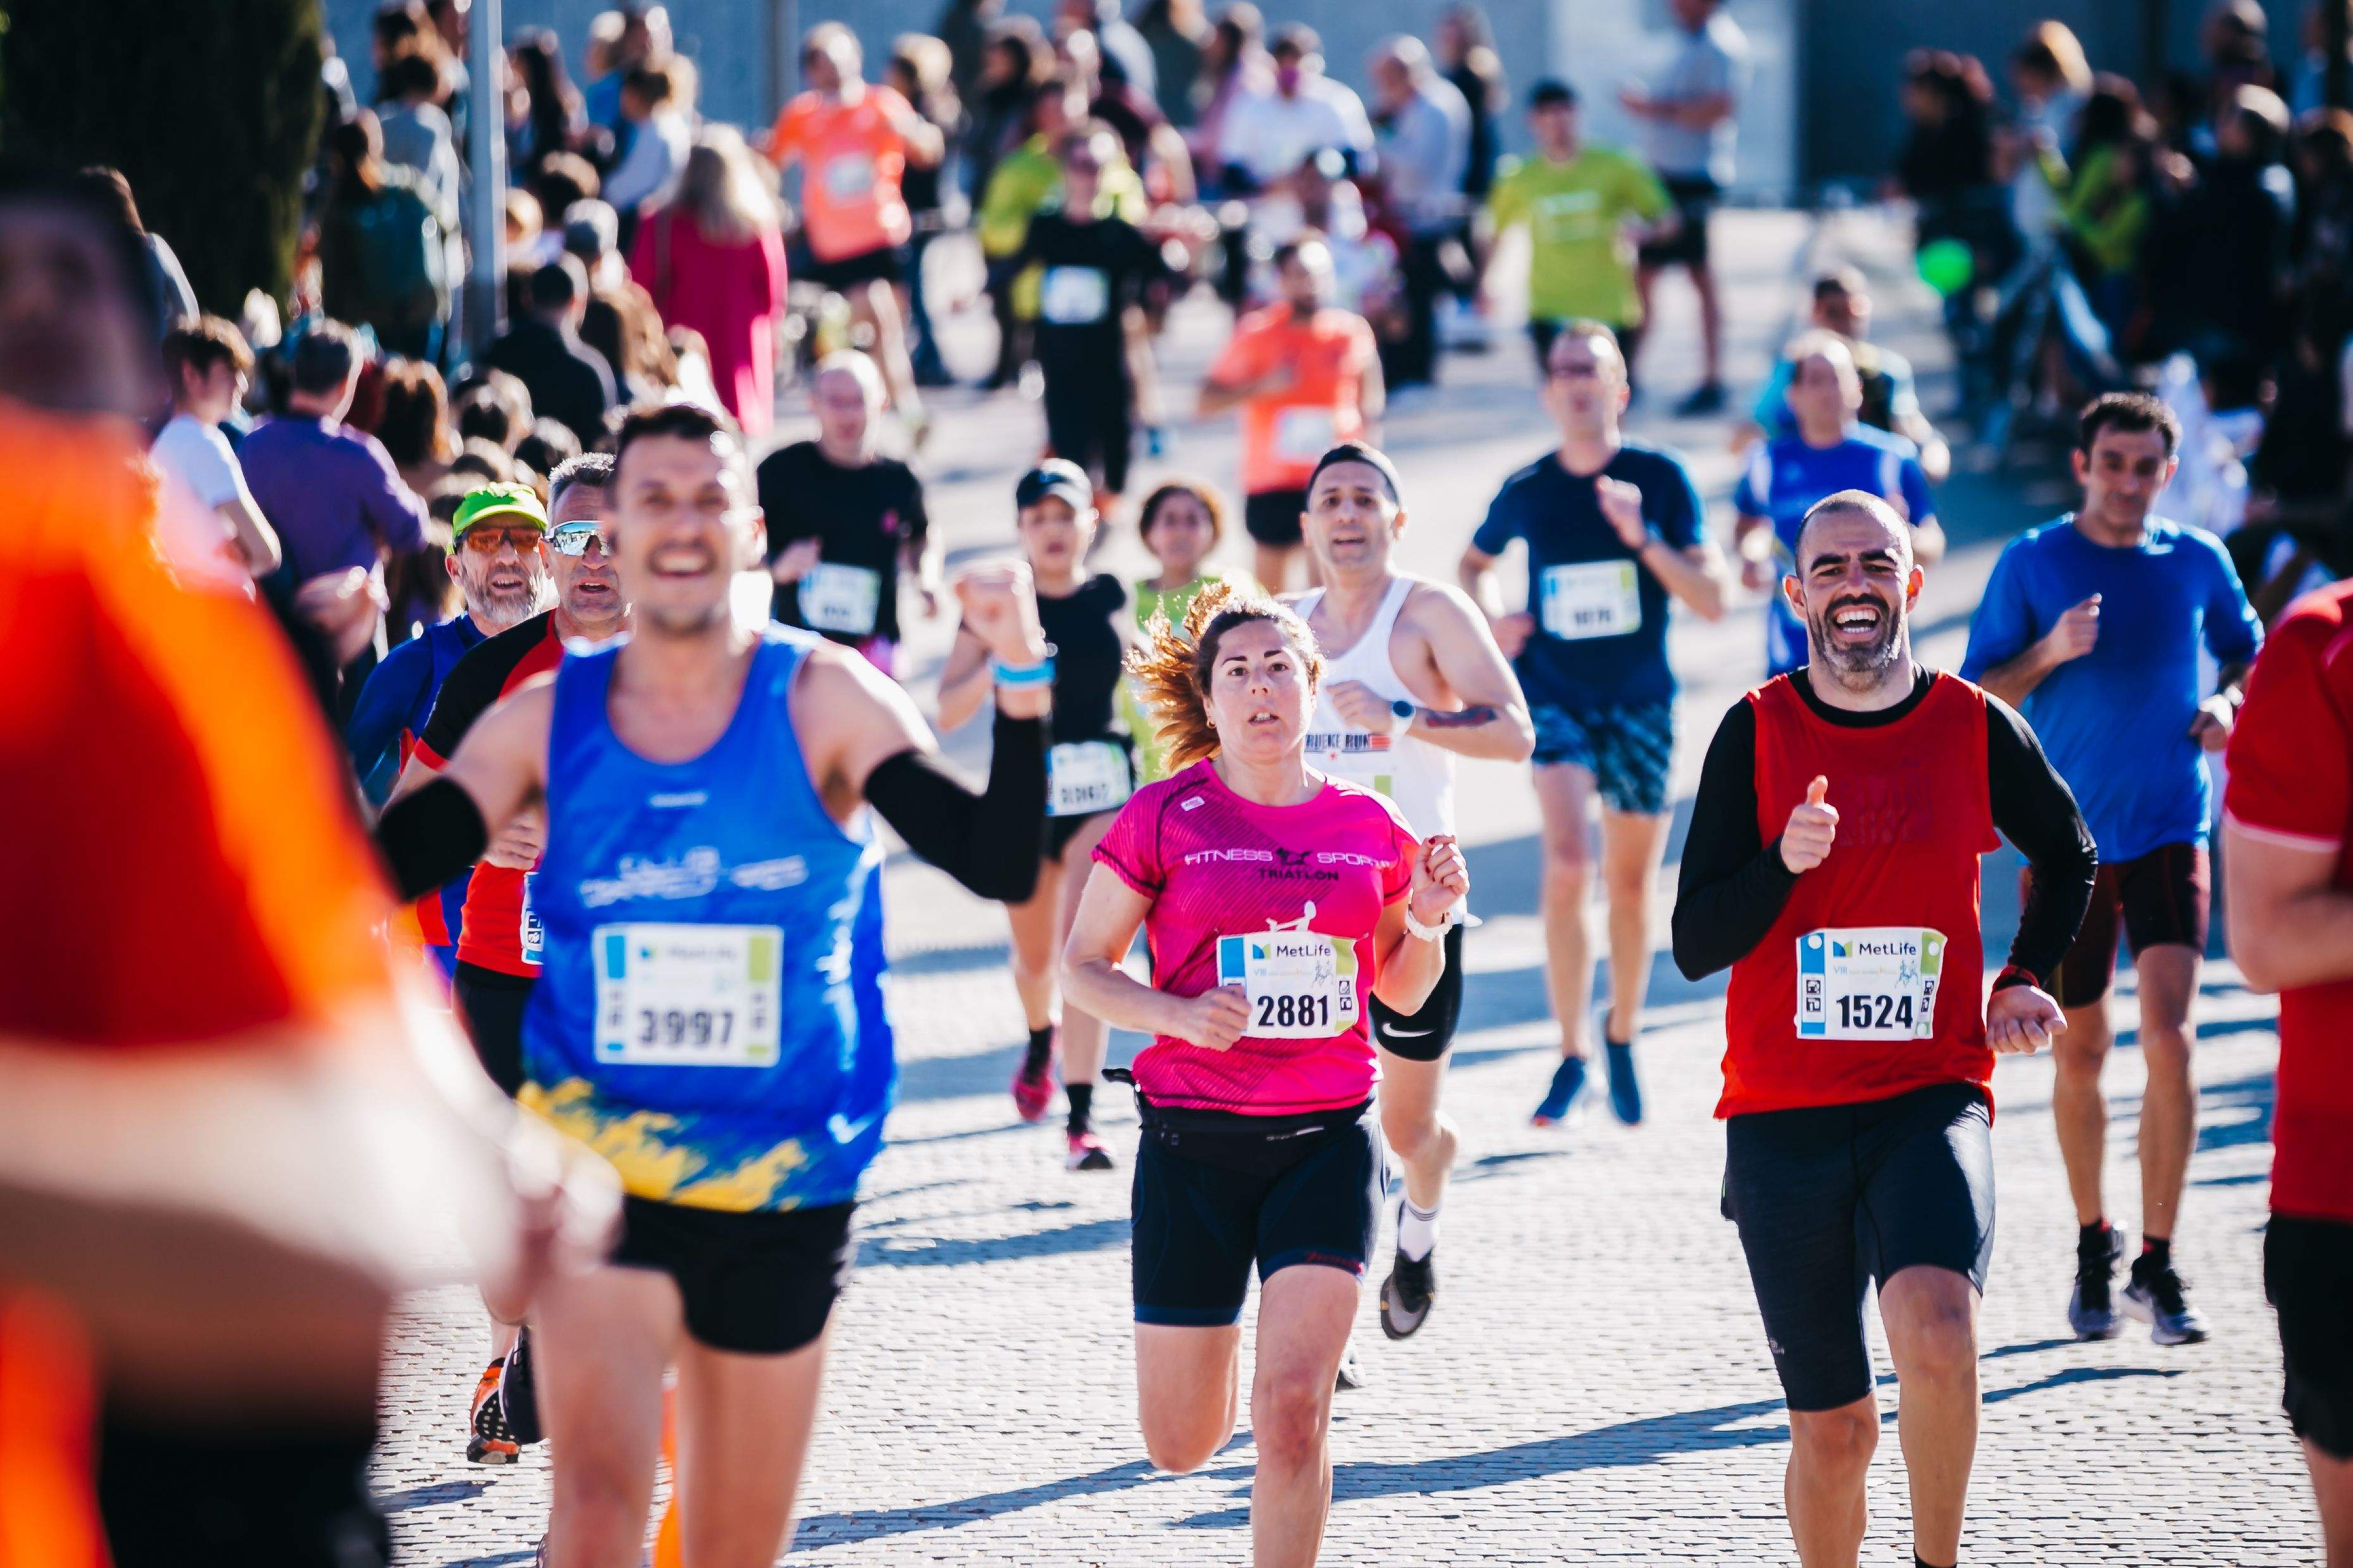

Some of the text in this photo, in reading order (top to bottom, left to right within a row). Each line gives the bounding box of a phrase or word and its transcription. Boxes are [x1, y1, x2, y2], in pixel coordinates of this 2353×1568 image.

[1184, 848, 1273, 865] FITNESS
[1277, 944, 1331, 957] MetLife
[1859, 942, 1916, 956] MetLife
[1257, 994, 1328, 1027] 2881
[1836, 995, 1913, 1029] 1524
[638, 1009, 735, 1047] 3997
